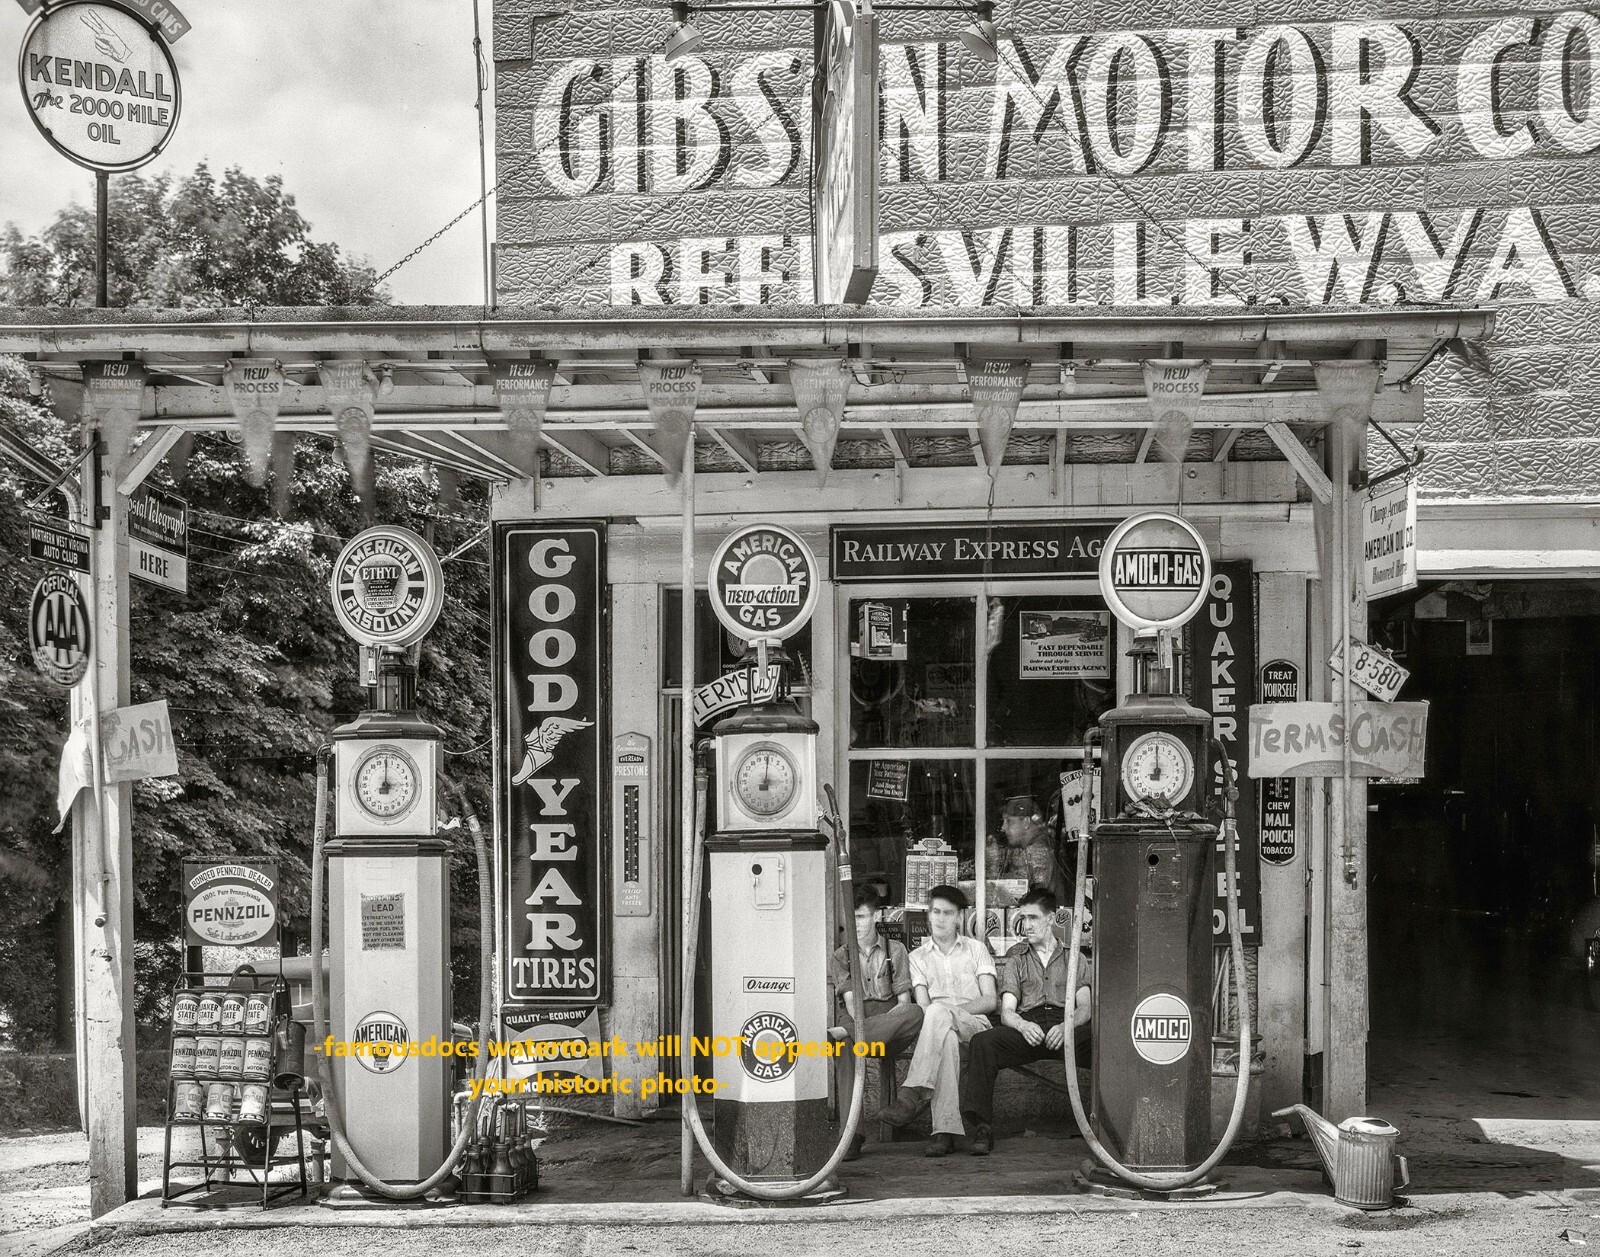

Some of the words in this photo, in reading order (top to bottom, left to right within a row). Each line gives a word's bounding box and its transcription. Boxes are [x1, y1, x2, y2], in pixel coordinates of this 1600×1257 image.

[150, 2, 183, 35] CANS
[30, 53, 172, 102] KENDALL
[33, 88, 64, 111] The
[69, 94, 124, 119] 2000
[127, 103, 169, 127] MILE
[533, 43, 948, 197] GIBSN
[984, 22, 1443, 180] MOTOR
[87, 122, 121, 145] OIL
[103, 363, 129, 377] NEW
[243, 366, 270, 381] NEW
[509, 364, 536, 377] NEW
[660, 367, 686, 380] NEW
[984, 362, 1011, 374] NEW
[1164, 367, 1190, 380] NEW
[90, 378, 142, 390] PERFORMANCE
[233, 382, 280, 394] PROCESS
[496, 379, 549, 390] PERFORMANCE
[649, 381, 696, 393] PROCESS
[970, 376, 1023, 388] PERFORMANCE
[1153, 382, 1199, 394] PROCESS
[128, 494, 148, 519] ostal
[56, 534, 68, 549] WEST
[843, 540, 946, 562] RAILWAY
[953, 538, 1060, 560] EXPRESS
[1365, 532, 1395, 561] AMERICAN
[43, 545, 60, 560] AUTO
[62, 550, 78, 565] CLUB
[344, 540, 421, 577] AMERICAN
[724, 534, 808, 586] AMERICAN
[140, 550, 169, 579] HERE
[362, 566, 399, 580] ETHYL
[1115, 554, 1201, 585] AMOCO-GAS
[42, 575, 80, 605] OFFICIAL
[727, 586, 799, 604] new-action
[344, 594, 421, 632] GASOLINE
[739, 605, 781, 627] GAS
[45, 594, 80, 665] AAA
[1209, 574, 1238, 742] QUAKER
[1268, 671, 1293, 680] TREAT
[1355, 651, 1401, 691] 8-580
[1264, 683, 1297, 698] YOURSELF
[102, 713, 174, 766] CASH
[614, 765, 649, 777] PRESTONE
[1267, 802, 1291, 811] CHEW
[1265, 813, 1292, 827] MAIL
[1262, 829, 1294, 844] POUCH
[1262, 846, 1293, 855] TOBACCO
[191, 868, 216, 888] BONDED
[216, 866, 247, 877] PENNZOIL
[248, 869, 273, 888] DEALER
[193, 904, 270, 922] PENNZOIL
[371, 904, 395, 912] LEAD
[1213, 909, 1254, 935] OL
[220, 930, 258, 941] Lubrication
[513, 957, 595, 988] TIRES
[746, 979, 791, 992] Orange
[177, 1011, 195, 1019] STATE
[505, 1013, 541, 1025] QUALITY
[549, 1010, 587, 1021] ECONOMY
[355, 1023, 407, 1046] AMERICAN
[742, 1016, 794, 1047] AMERICAN
[1135, 1019, 1189, 1039] AMOCO
[753, 1063, 782, 1077] GAS
